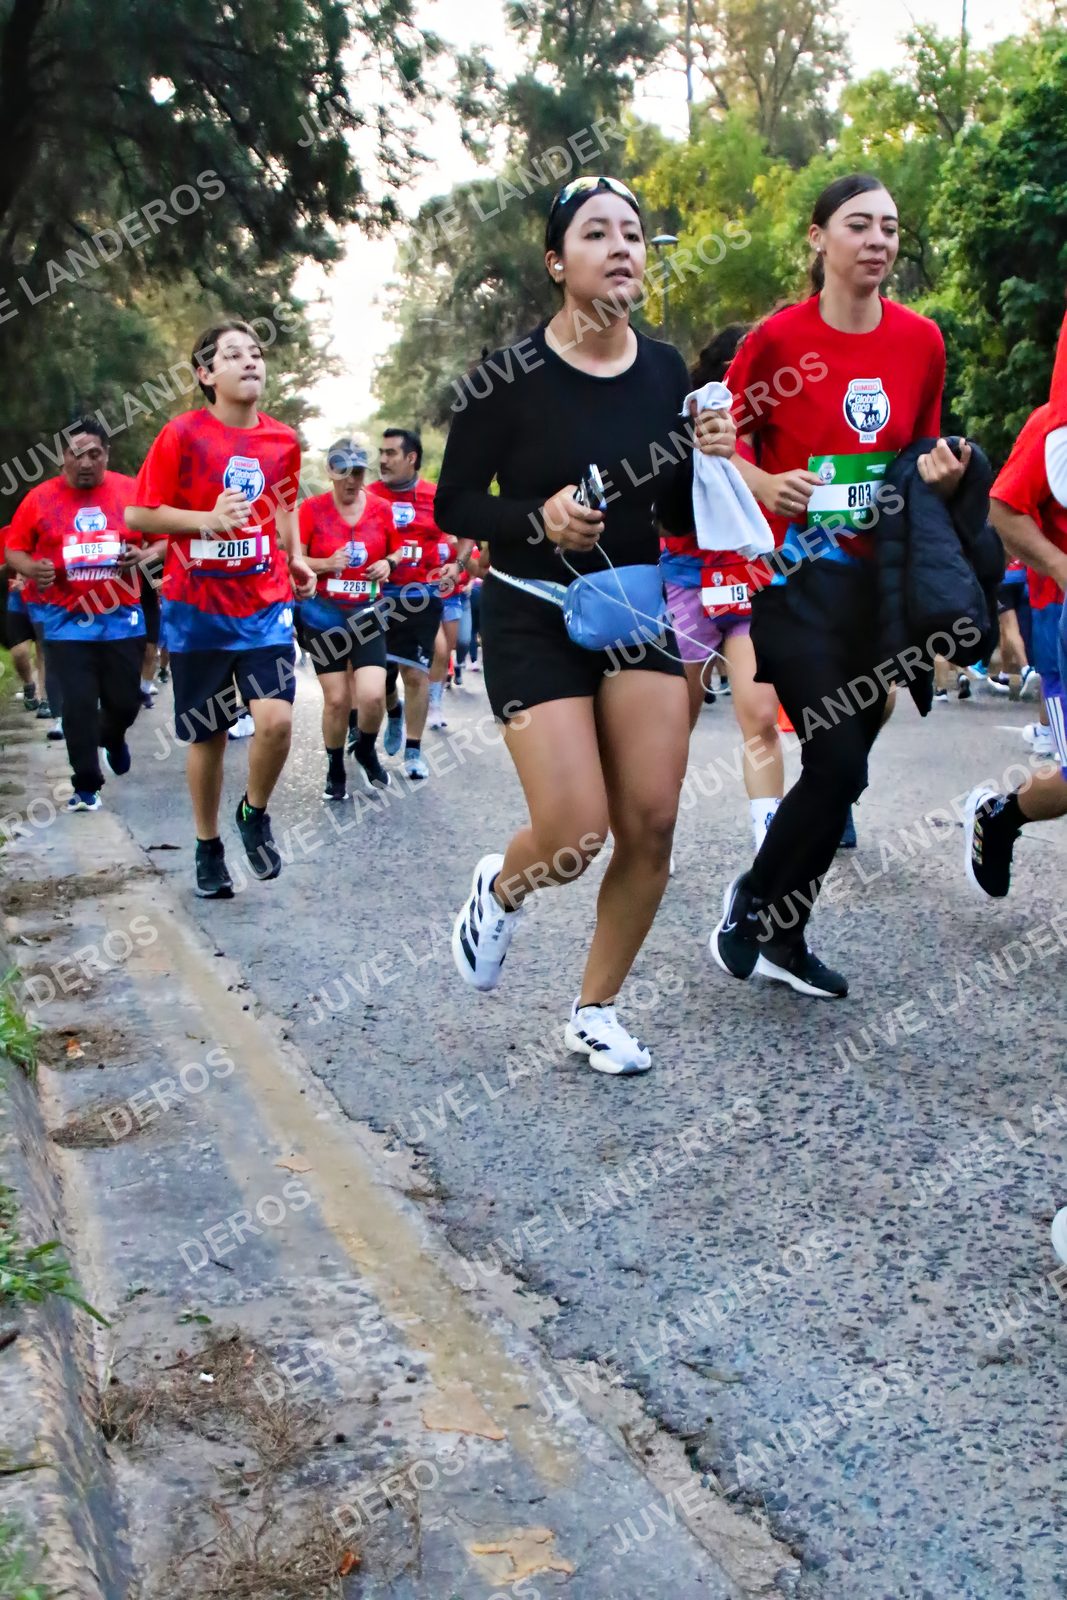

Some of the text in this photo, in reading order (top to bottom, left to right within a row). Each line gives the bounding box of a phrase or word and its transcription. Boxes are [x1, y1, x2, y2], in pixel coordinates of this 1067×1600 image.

[855, 394, 878, 404] Global
[851, 403, 870, 413] Race
[848, 483, 871, 507] 803
[80, 543, 103, 554] 1625
[218, 540, 249, 558] 2016
[343, 581, 367, 591] 2263
